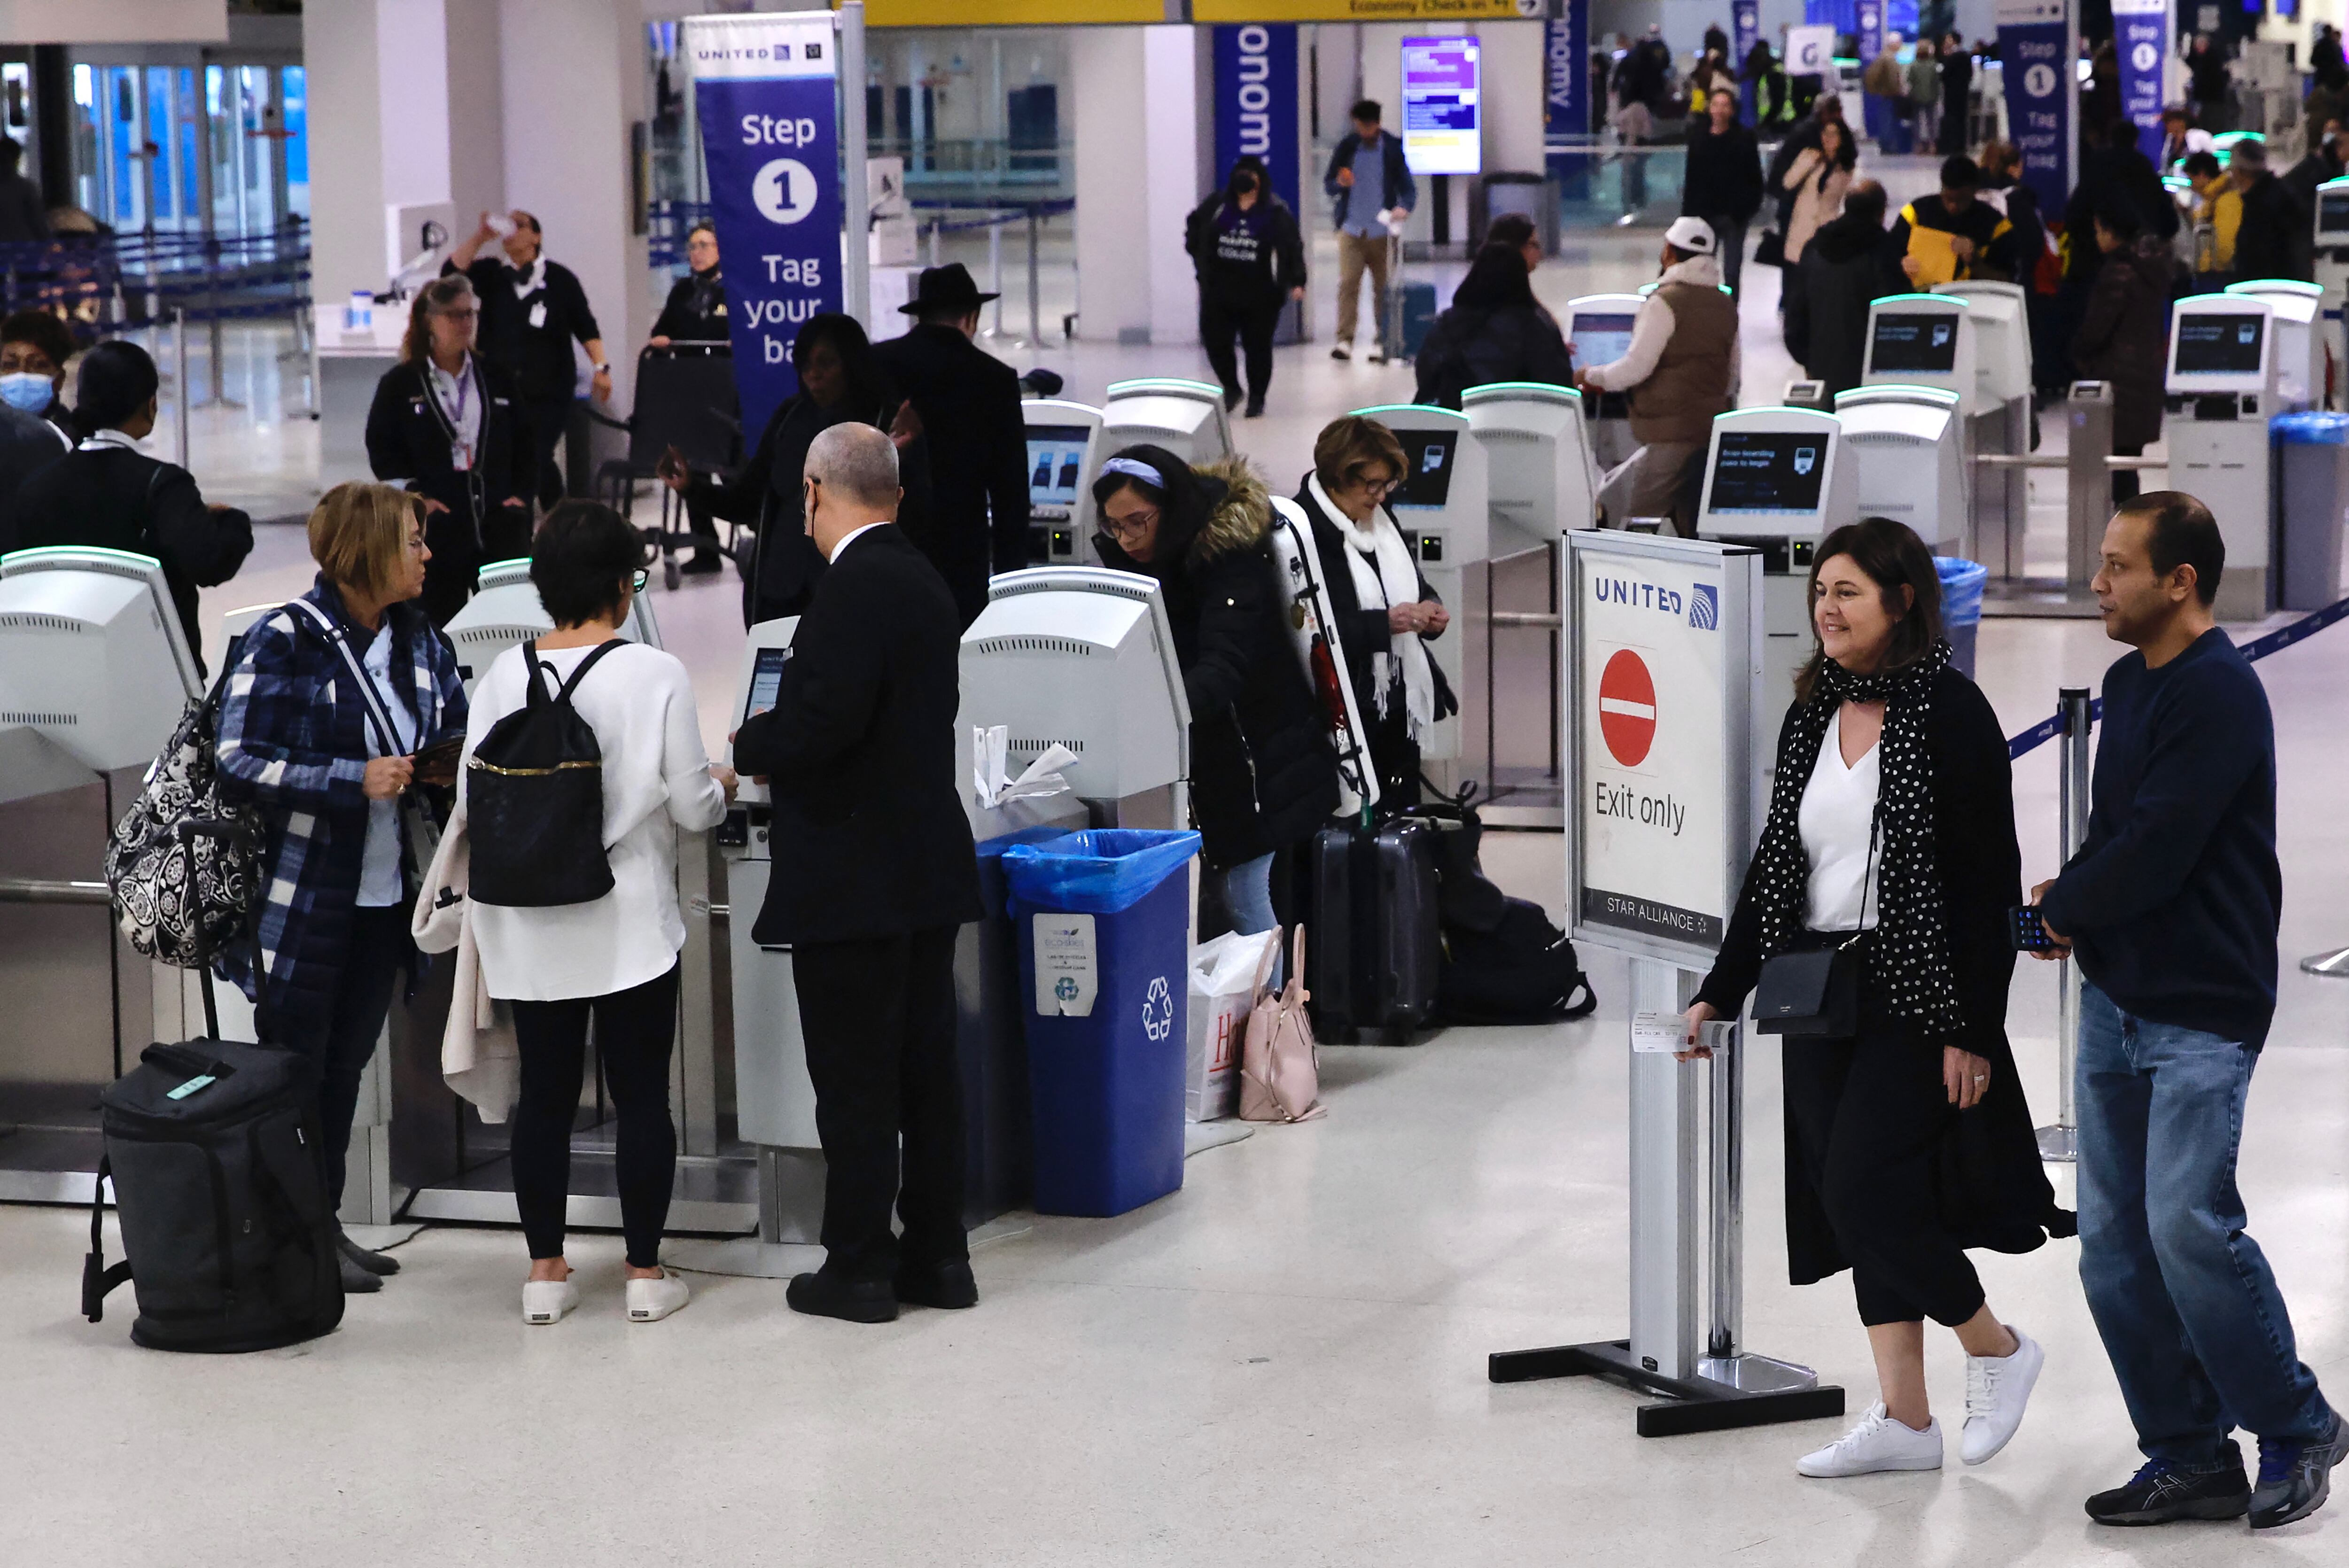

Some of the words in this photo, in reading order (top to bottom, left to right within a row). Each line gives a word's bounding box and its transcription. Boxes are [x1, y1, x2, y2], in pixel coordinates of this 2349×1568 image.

[699, 49, 769, 60] UNITED
[1802, 43, 1819, 66] G
[742, 115, 816, 148] Step
[773, 170, 796, 210] 1
[761, 254, 822, 287] Tag
[743, 298, 822, 329] your
[1596, 577, 1681, 614] UNITED
[1597, 782, 1634, 820] Exit
[1641, 793, 1685, 837] only
[1607, 897, 1635, 916] STAR
[1638, 904, 1694, 931] ALLIANCE
